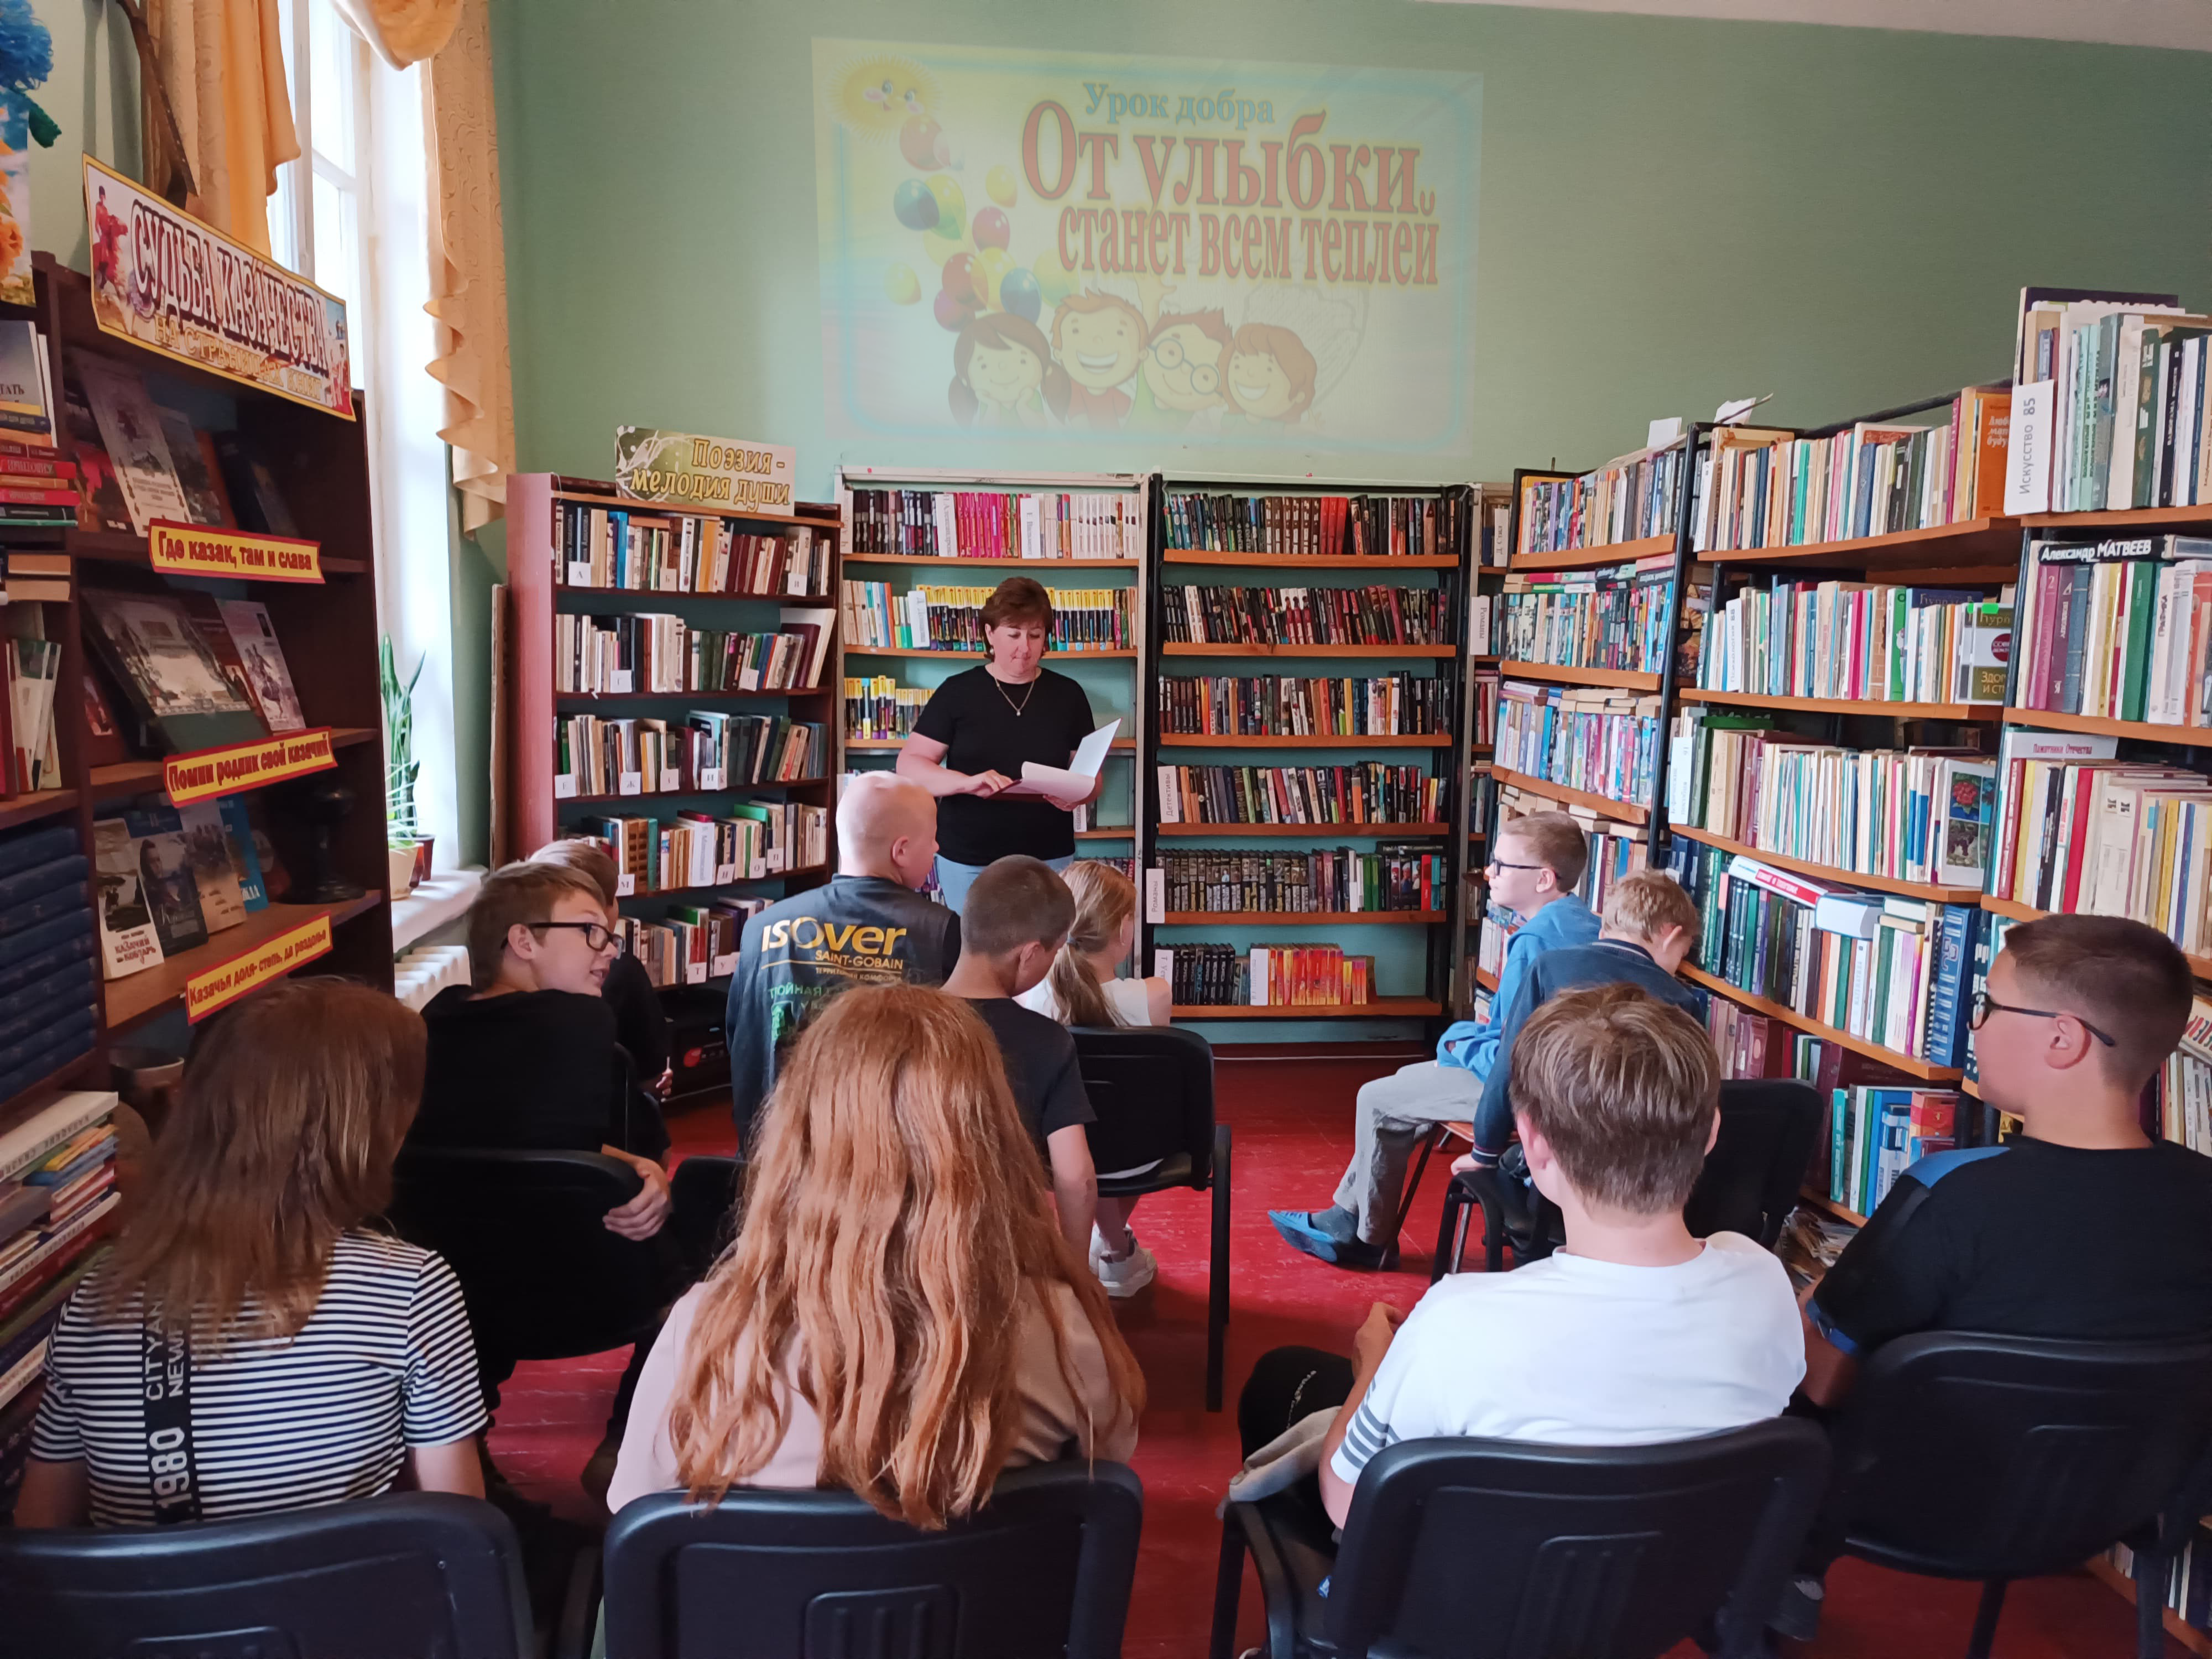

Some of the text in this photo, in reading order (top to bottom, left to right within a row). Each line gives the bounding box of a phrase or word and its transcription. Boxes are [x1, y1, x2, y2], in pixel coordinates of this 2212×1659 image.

[1083, 82, 1275, 131] Урок добра
[1022, 100, 1118, 200] От
[1058, 206, 1191, 276] станет
[1199, 213, 1293, 279] всем
[131, 199, 330, 378] СУДЬБА КАЗАЧЕСТВА
[154, 314, 323, 401] НА СТРАНИЦАХ КНИГ
[692, 439, 773, 474] Поэзия
[2019, 398, 2036, 494] Искусство 85
[630, 468, 790, 513] мелодия души
[158, 531, 312, 571] Где казак, там и слава
[2041, 539, 2152, 563] Александр МАТВЕЕВ
[1479, 607, 1488, 639] Романы
[1729, 625, 1737, 683] Психология
[169, 734, 330, 792] Помни родник свой казачий
[1164, 773, 1173, 817] Детективы
[1150, 880, 1159, 913] Романы
[190, 974, 232, 1006] Казачья
[259, 953, 283, 972] степь,
[284, 946, 293, 962] да
[295, 930, 326, 957] раздолье
[815, 950, 904, 970] SAINT-GOBAIN
[769, 982, 822, 999] ТОЙНАЯ
[149, 1427, 192, 1509] 1980
